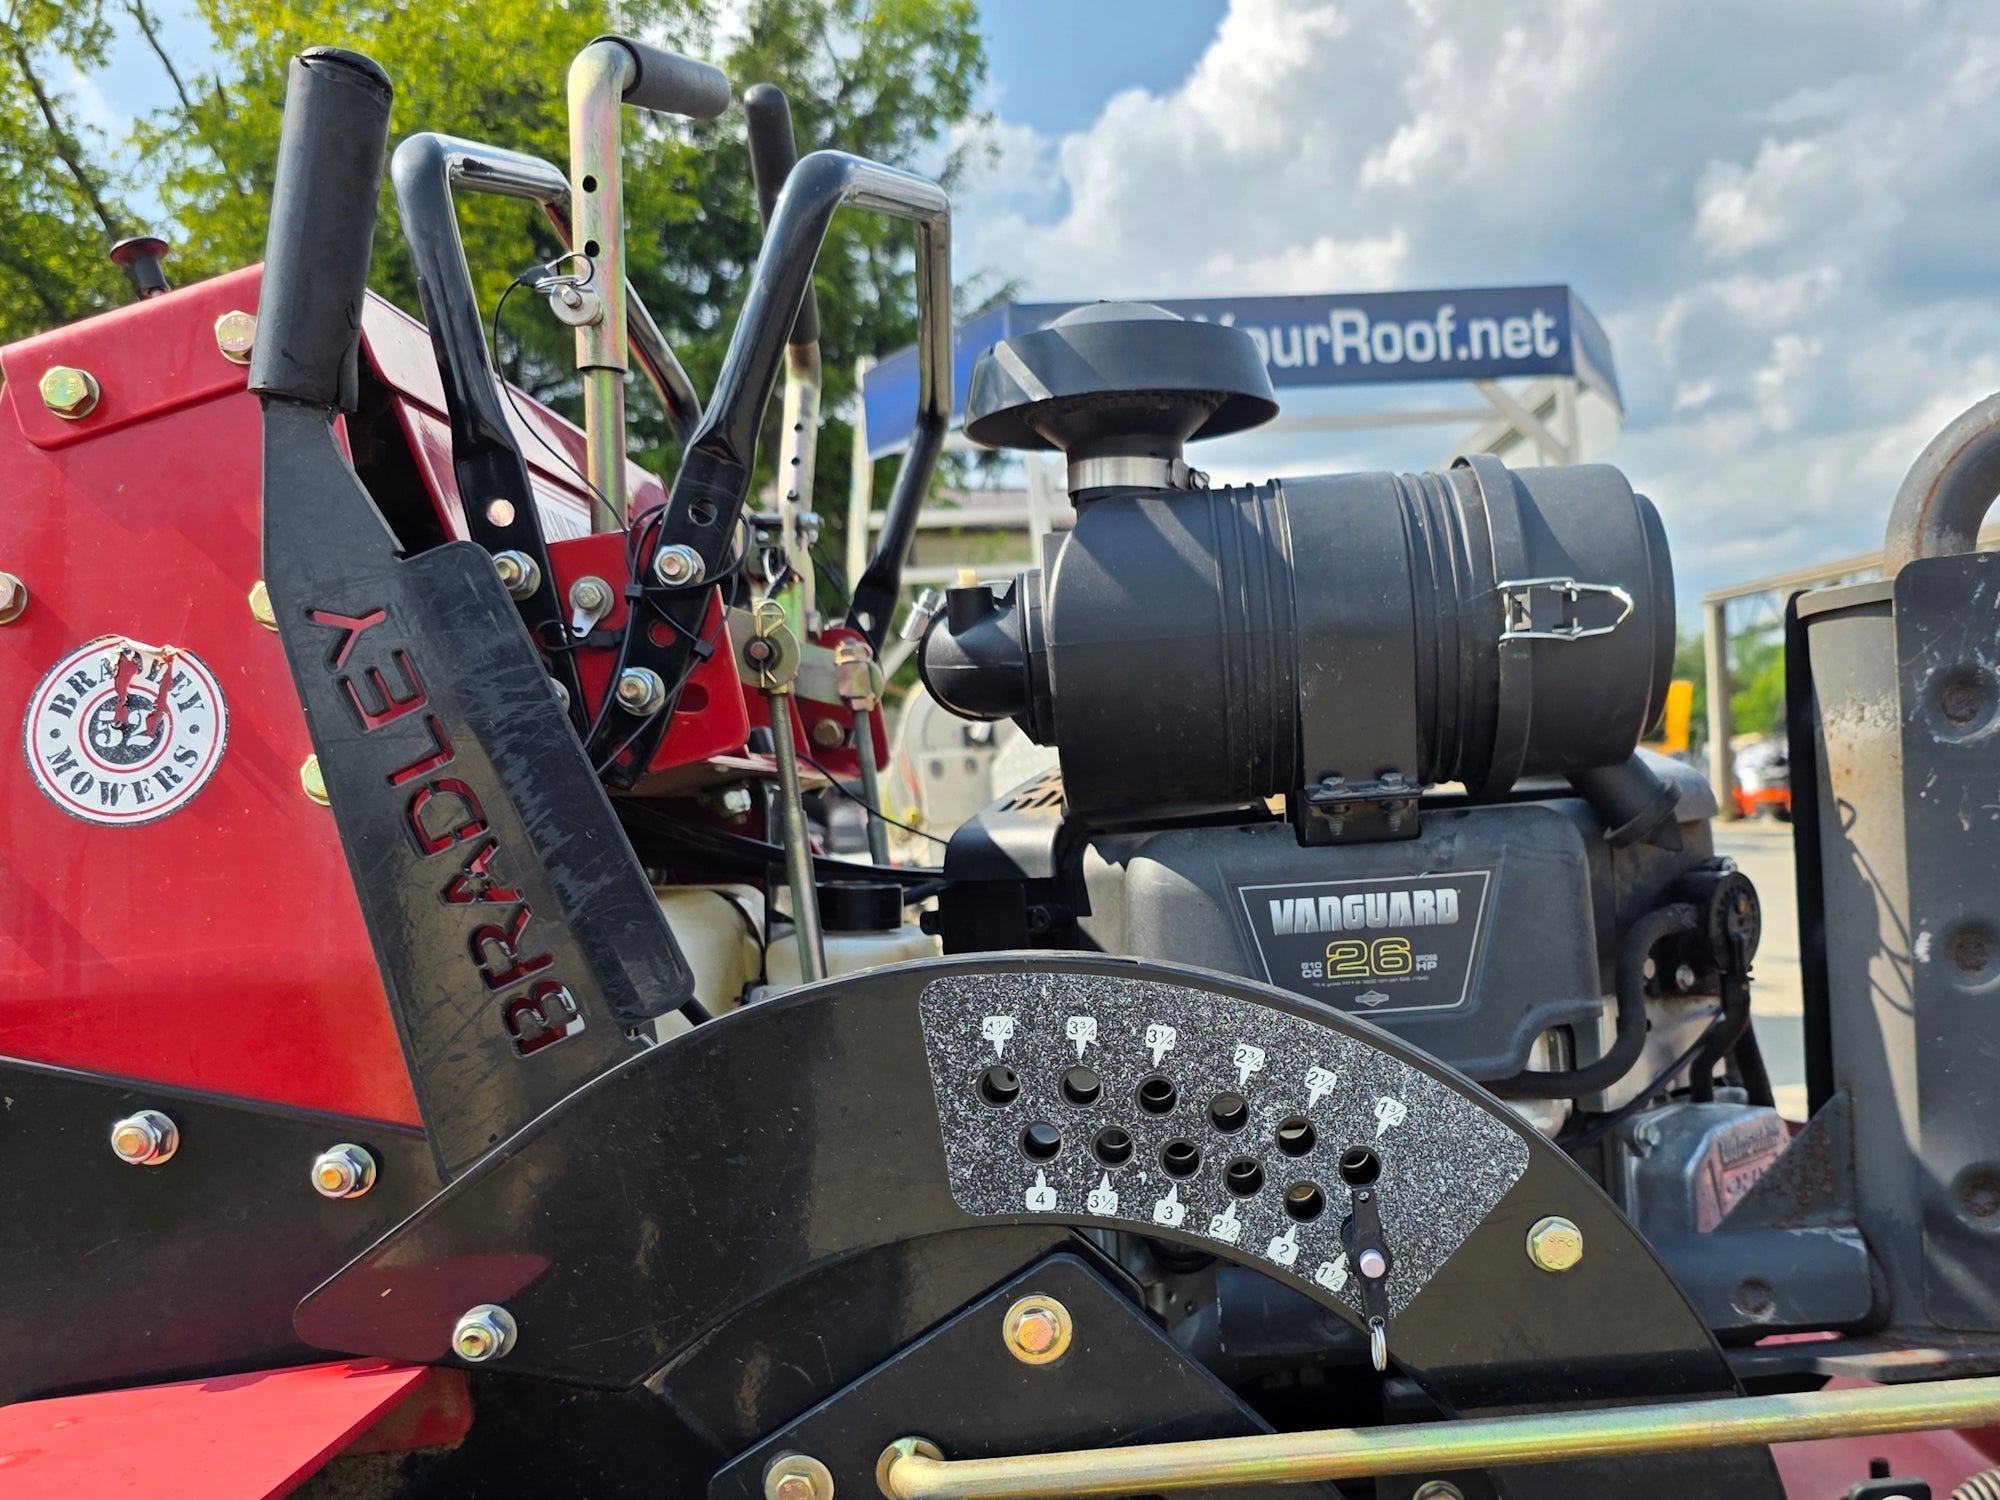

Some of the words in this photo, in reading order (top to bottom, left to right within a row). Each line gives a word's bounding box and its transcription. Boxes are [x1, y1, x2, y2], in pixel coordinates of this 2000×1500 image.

[1193, 306, 1560, 368] ourRoof.net
[95, 708, 158, 748] 52
[46, 744, 199, 807] MOWERS
[305, 607, 588, 1059] BRADLEY
[1268, 888, 1460, 936] VANGUARD
[1301, 969, 1323, 979] CC
[1326, 936, 1412, 979] 26
[1416, 961, 1438, 972] HP
[1035, 1190, 1045, 1206] 4
[1163, 1205, 1174, 1220] 3
[1278, 1243, 1290, 1259] 2
